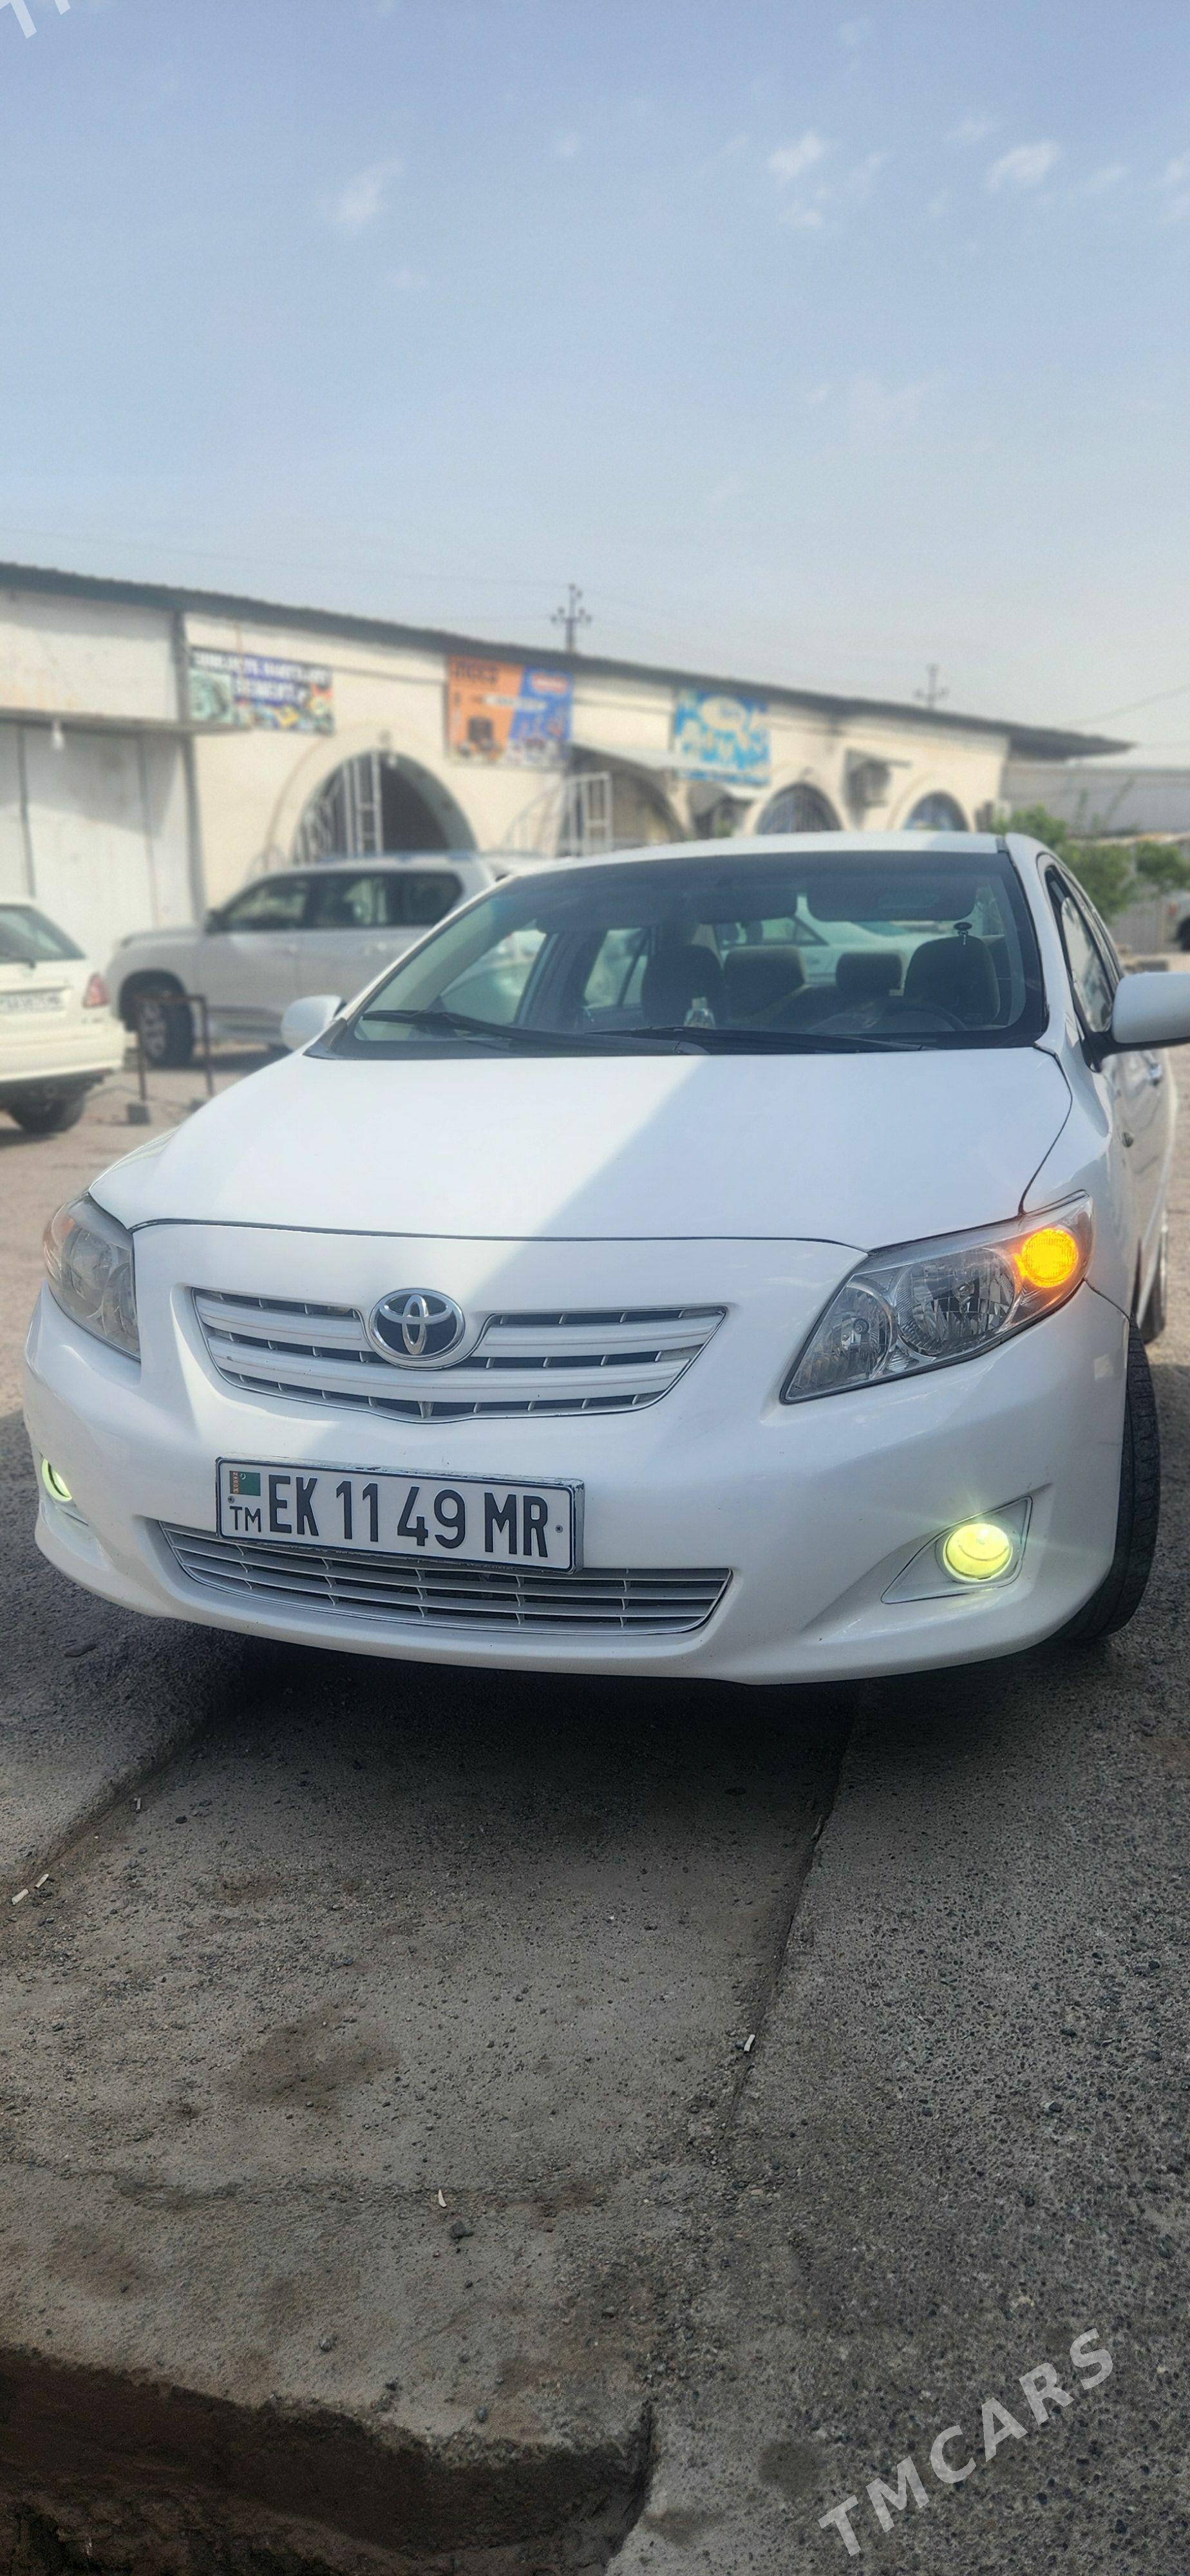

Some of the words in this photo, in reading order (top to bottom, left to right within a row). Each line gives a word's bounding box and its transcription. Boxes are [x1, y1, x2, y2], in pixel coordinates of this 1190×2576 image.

[229, 1505, 261, 1533] TM
[268, 1474, 319, 1537] EK
[484, 1492, 548, 1558] MR
